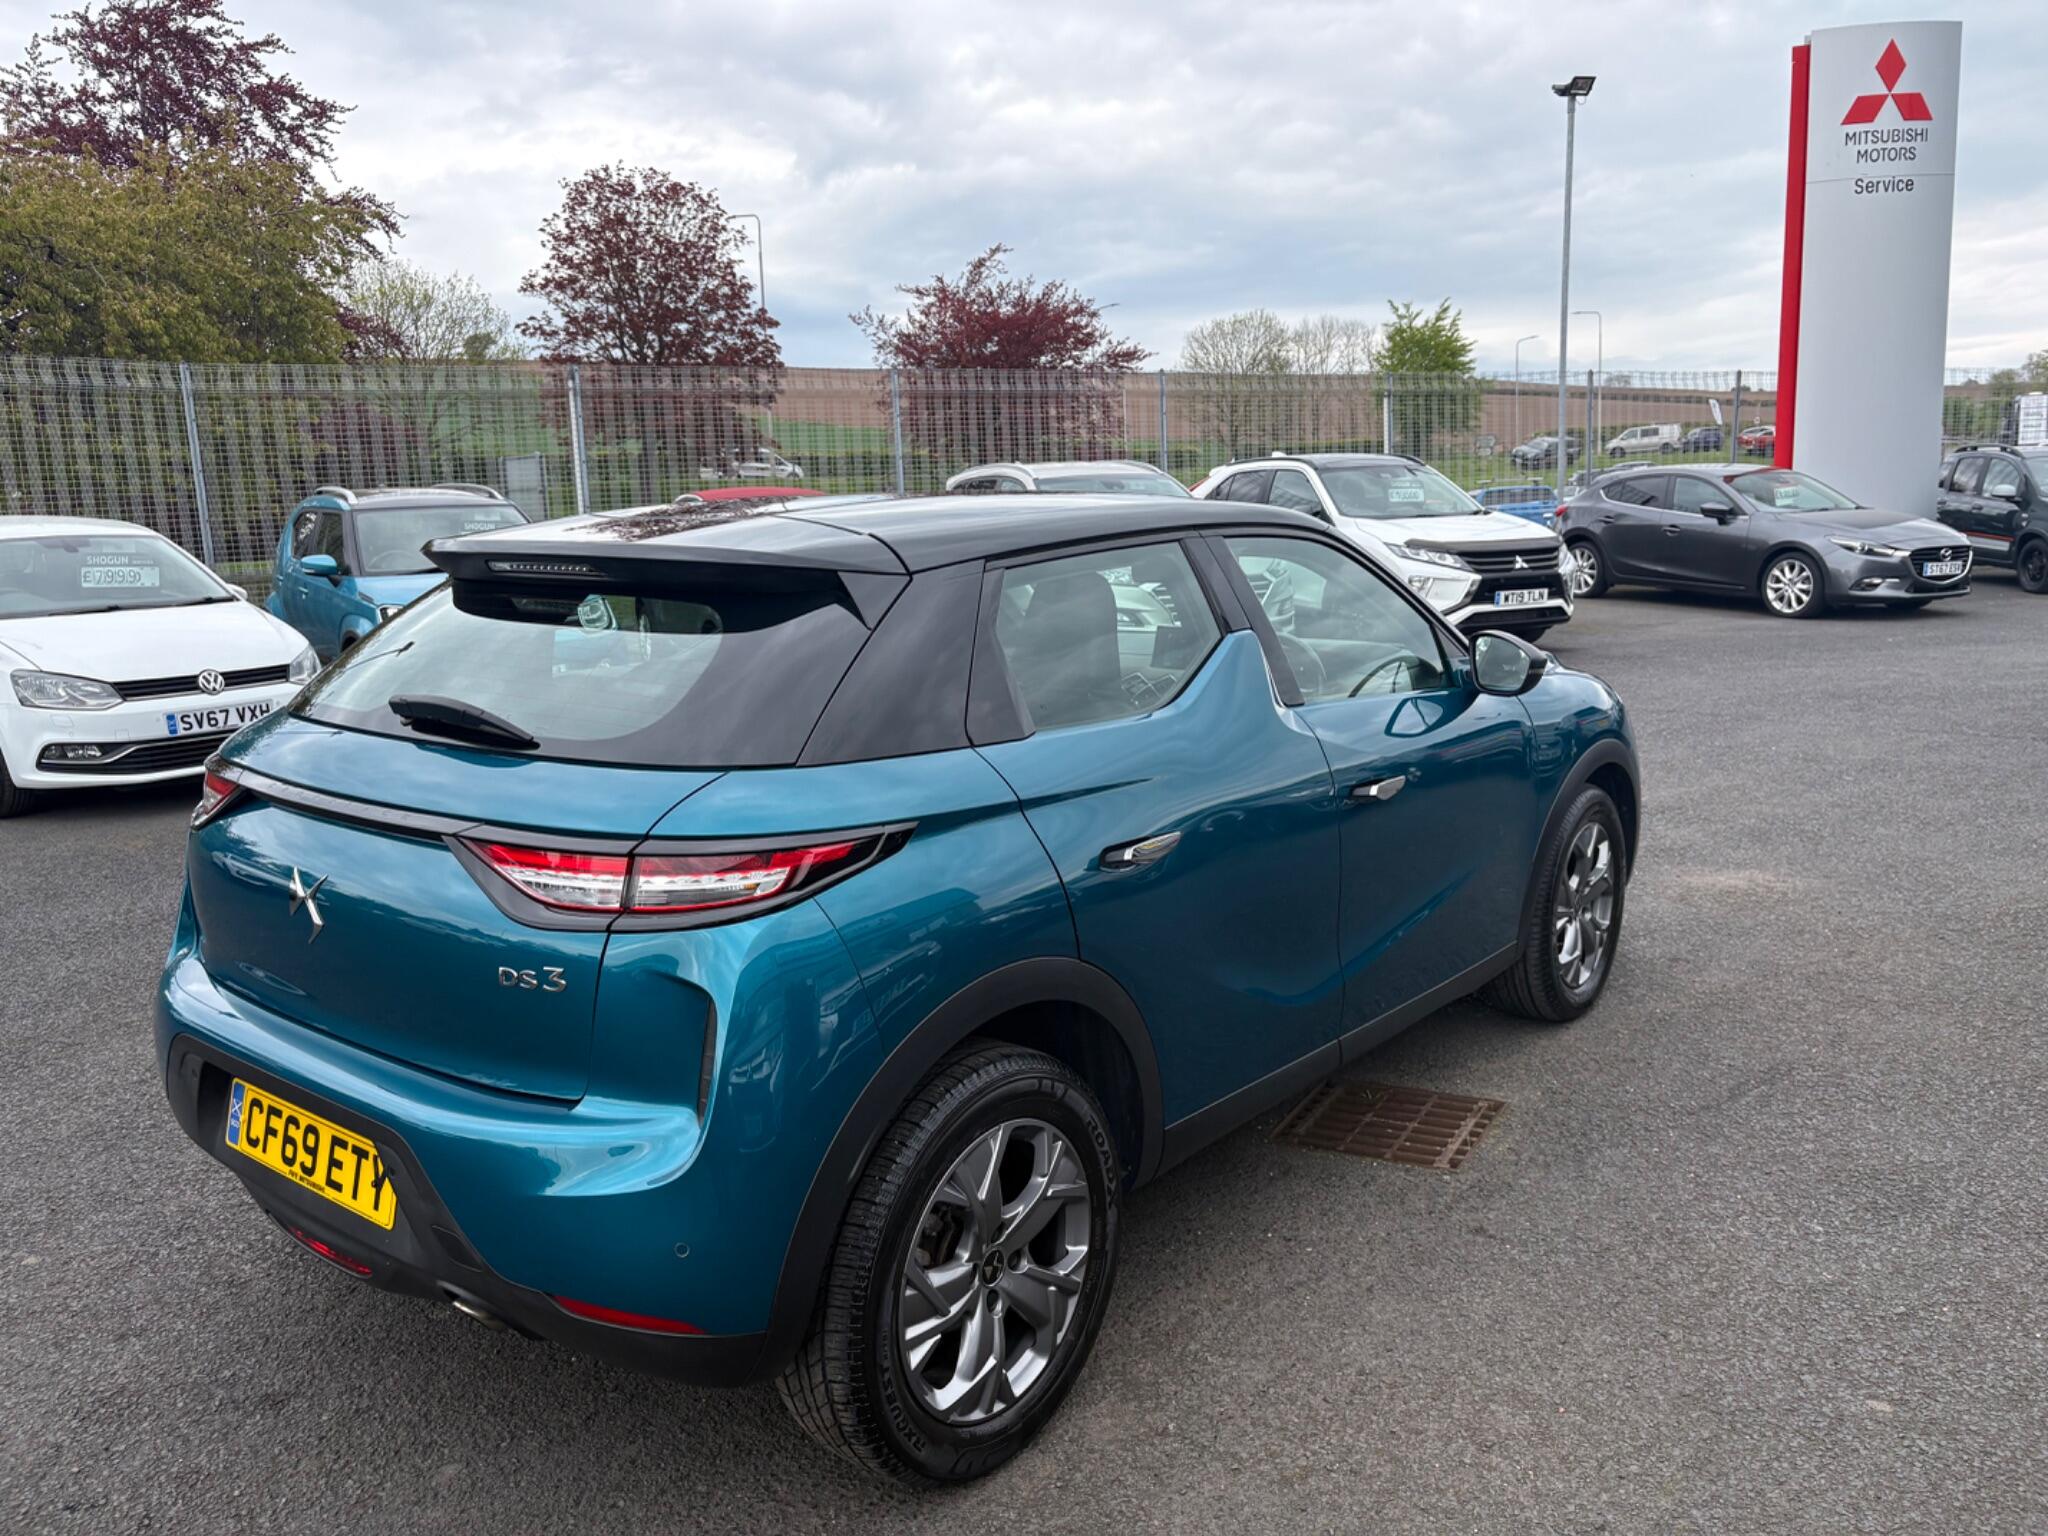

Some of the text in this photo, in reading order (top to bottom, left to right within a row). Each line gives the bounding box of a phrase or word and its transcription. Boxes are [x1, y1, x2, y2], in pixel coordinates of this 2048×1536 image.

[1844, 128, 1929, 146] MITSUBISHI
[1856, 146, 1917, 164] MOTORS
[1854, 176, 1914, 194] Service
[86, 555, 129, 565] SHOGUN
[180, 708, 230, 731] SV67
[246, 1097, 389, 1212] CF69 ETY
